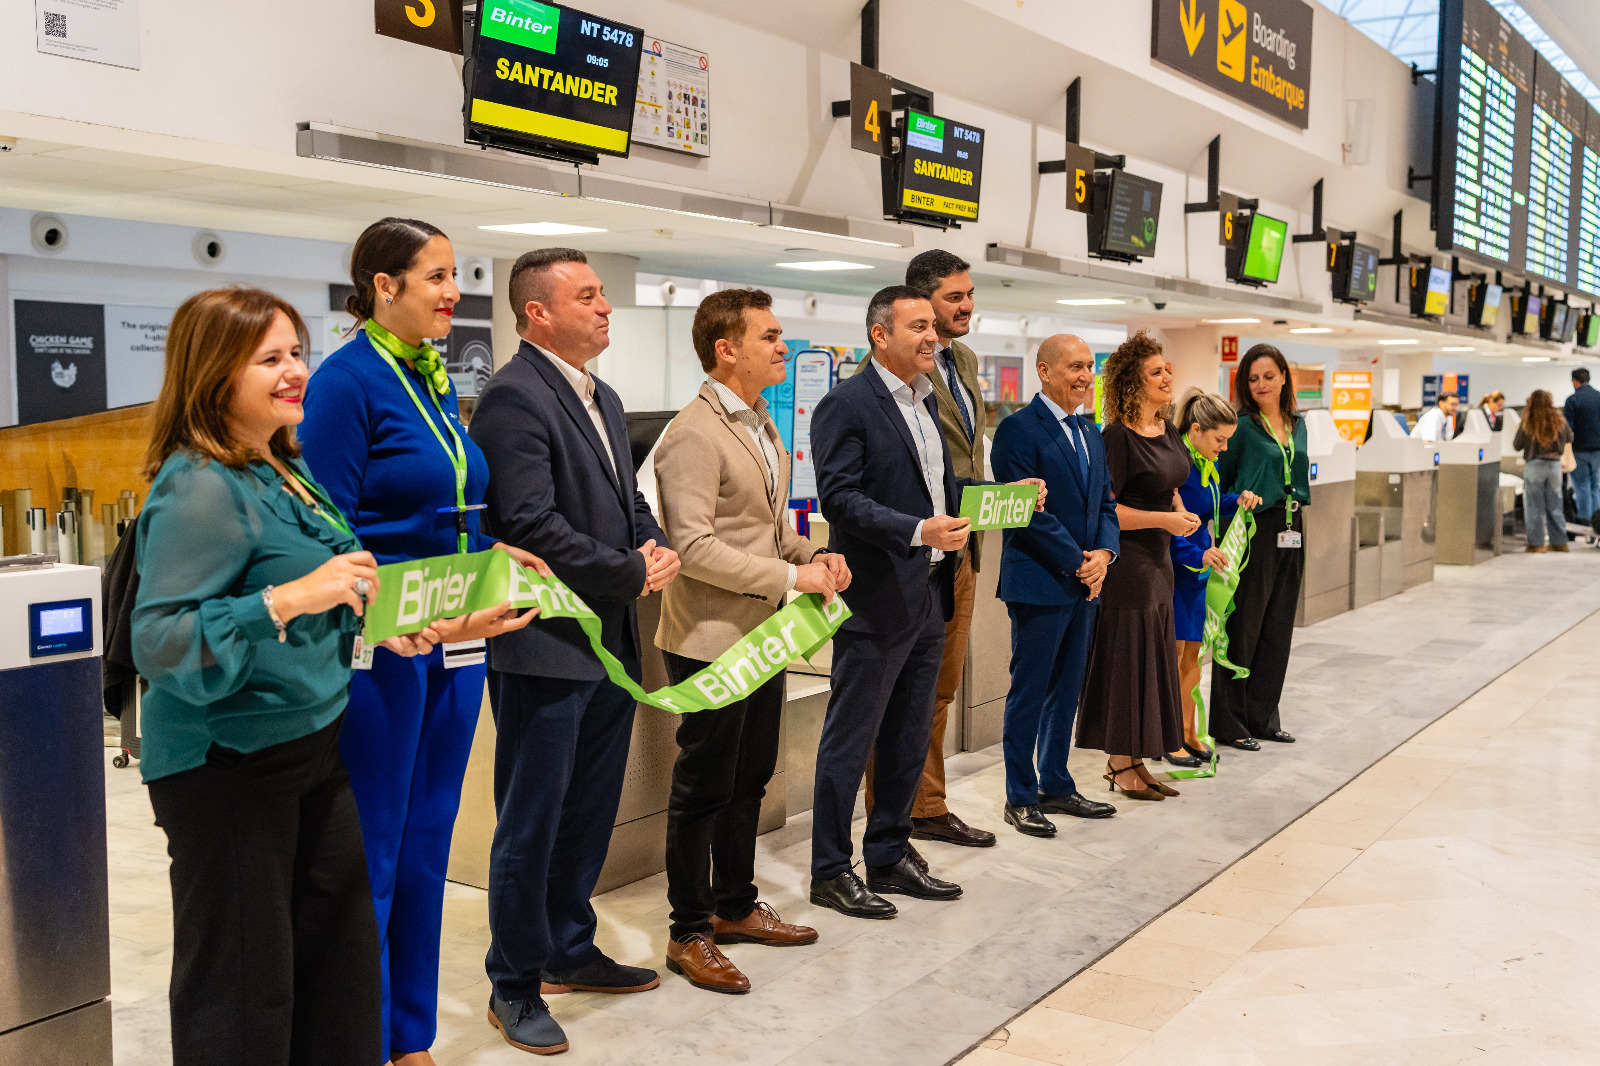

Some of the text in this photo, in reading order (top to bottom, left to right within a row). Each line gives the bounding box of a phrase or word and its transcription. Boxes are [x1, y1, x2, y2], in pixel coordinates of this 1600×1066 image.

[490, 7, 552, 35] Binter
[580, 19, 634, 48] NT 5478
[1252, 12, 1297, 71] Boarding
[586, 54, 609, 68] 09:05
[495, 57, 618, 106] SANTANDER
[1250, 54, 1305, 111] Embarque
[864, 99, 881, 143] 4
[916, 117, 938, 131] Binter
[953, 126, 981, 144] NT 5478
[913, 158, 973, 186] SANTANDER
[1074, 168, 1087, 204] 5
[910, 194, 935, 207] BINTER
[943, 201, 955, 210] FACT
[955, 203, 967, 212] PREF
[1224, 211, 1233, 241] 6
[1330, 243, 1337, 267] 7
[121, 321, 137, 329] The
[978, 490, 1033, 526] Binter
[396, 565, 478, 627] Binter
[362, 649, 372, 664] 27
[692, 619, 801, 705] Binter
